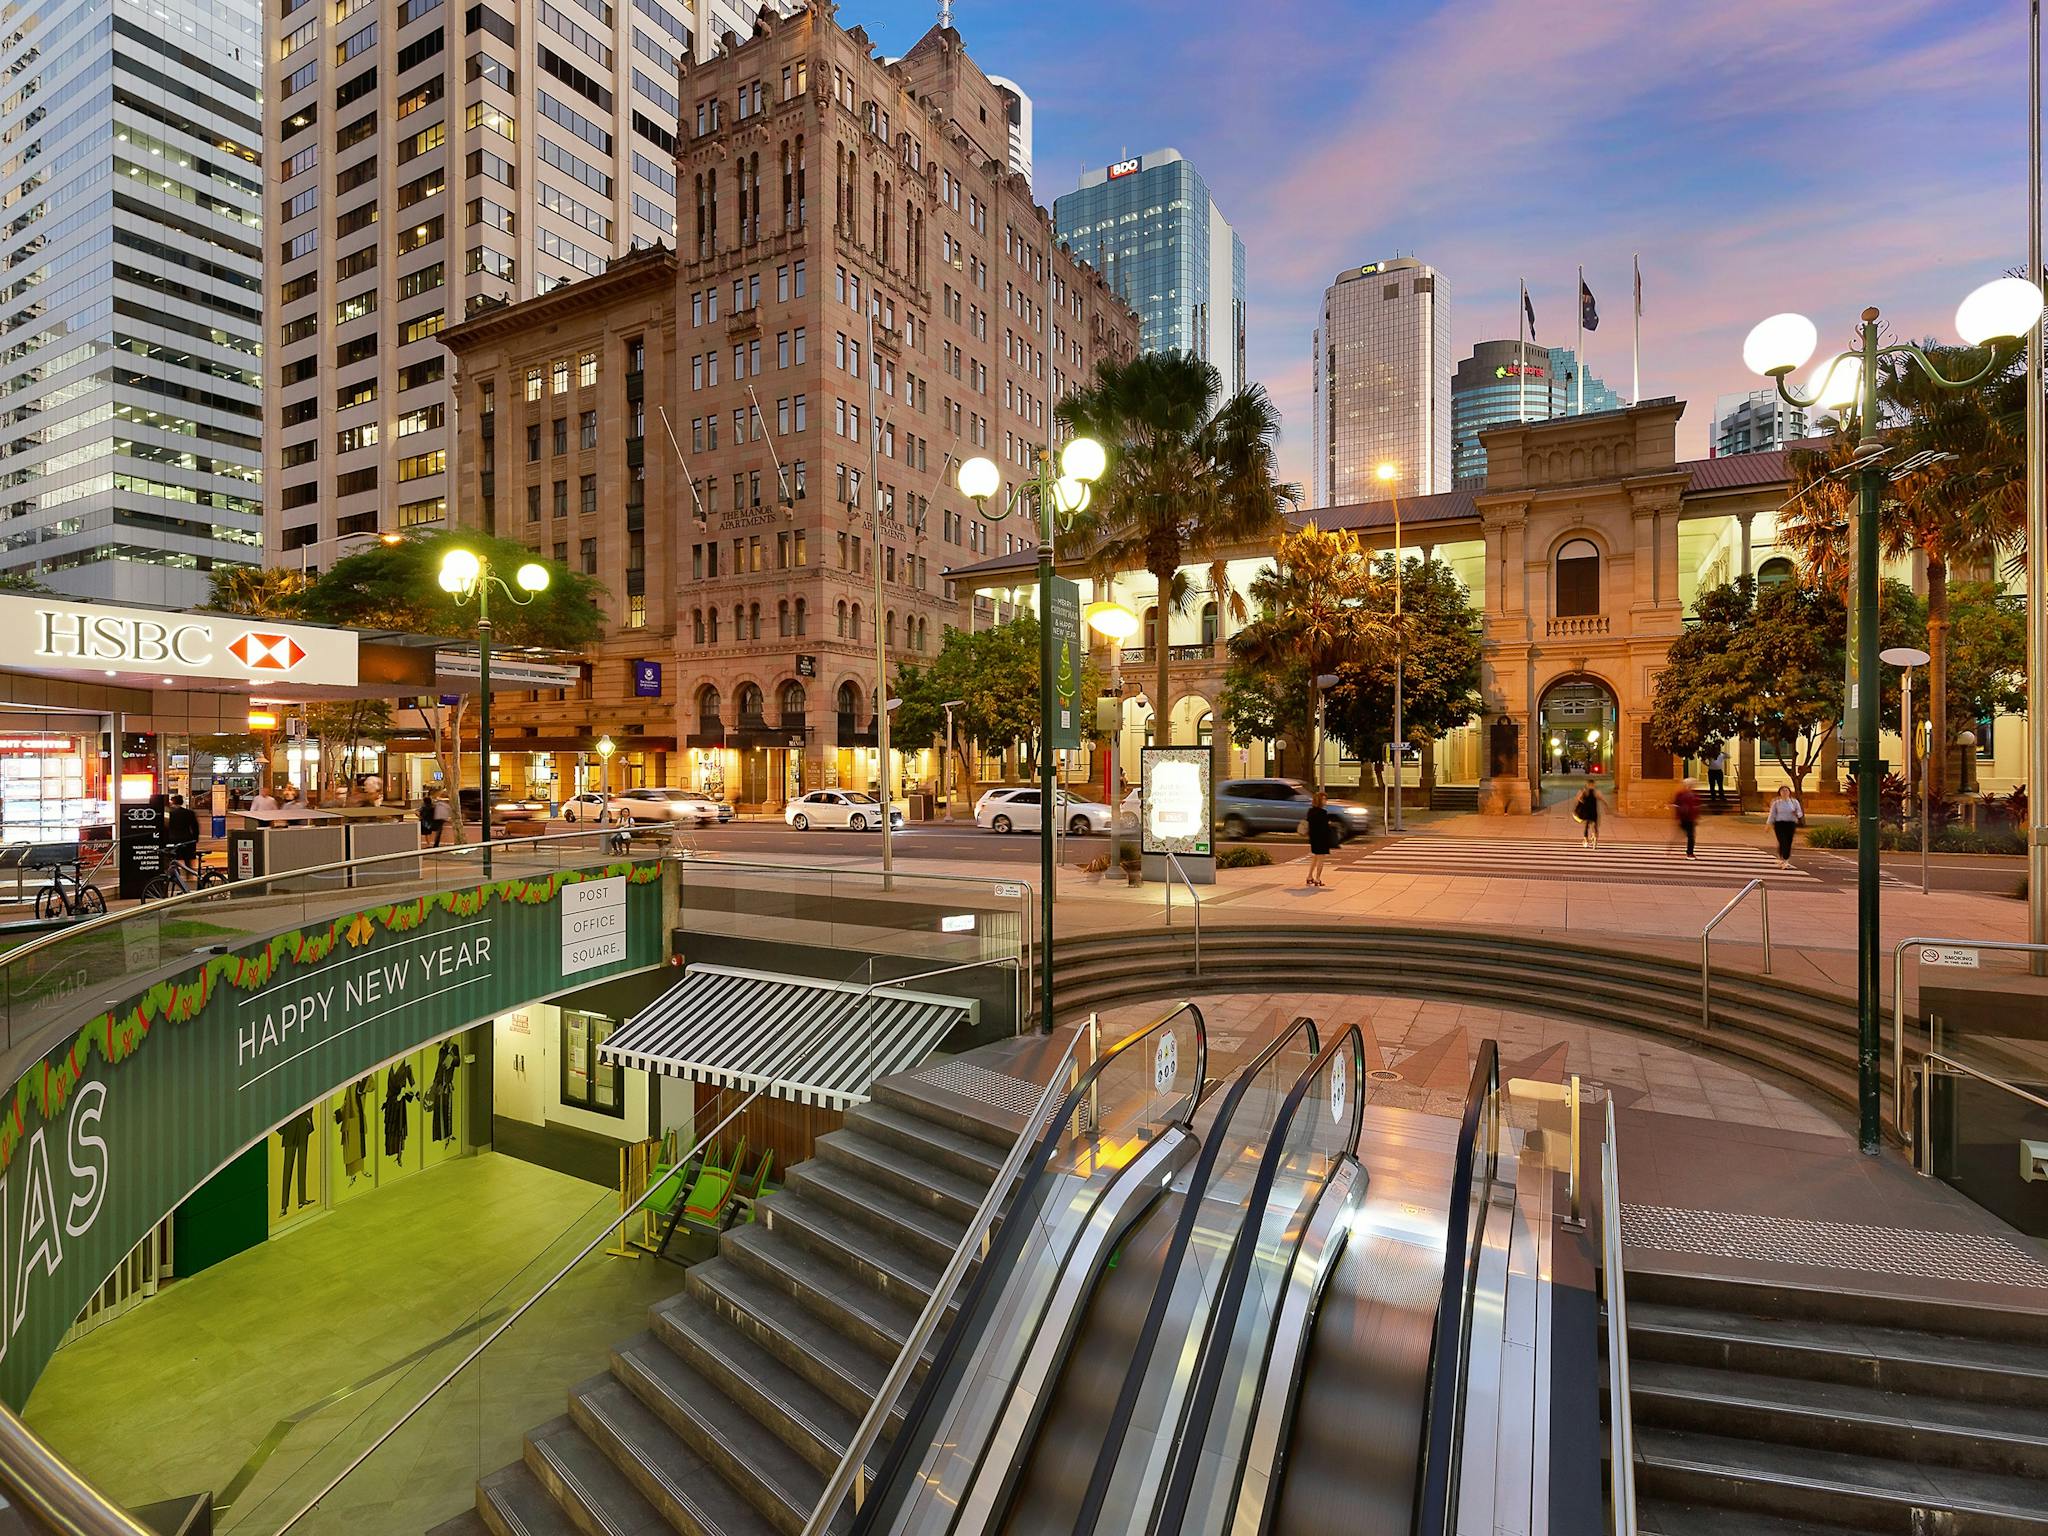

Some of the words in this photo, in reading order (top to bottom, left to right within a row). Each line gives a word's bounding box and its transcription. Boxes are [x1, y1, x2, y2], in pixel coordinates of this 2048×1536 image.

[1112, 159, 1138, 176] BDO
[1362, 265, 1376, 275] CPA
[719, 514, 776, 530] APARTMENTS
[722, 511, 740, 521] THE
[740, 505, 773, 518] MANOR
[863, 520, 907, 542] APTMENTS
[35, 610, 212, 666] HSBC
[128, 808, 156, 821] 300
[579, 887, 609, 902] POST
[573, 914, 616, 933] OFFICE
[572, 942, 620, 963] SQUARE.
[238, 985, 335, 1066] HAPPY
[346, 959, 409, 1012] NEW
[419, 936, 491, 981] YEAR
[0, 1080, 108, 1362] AS
